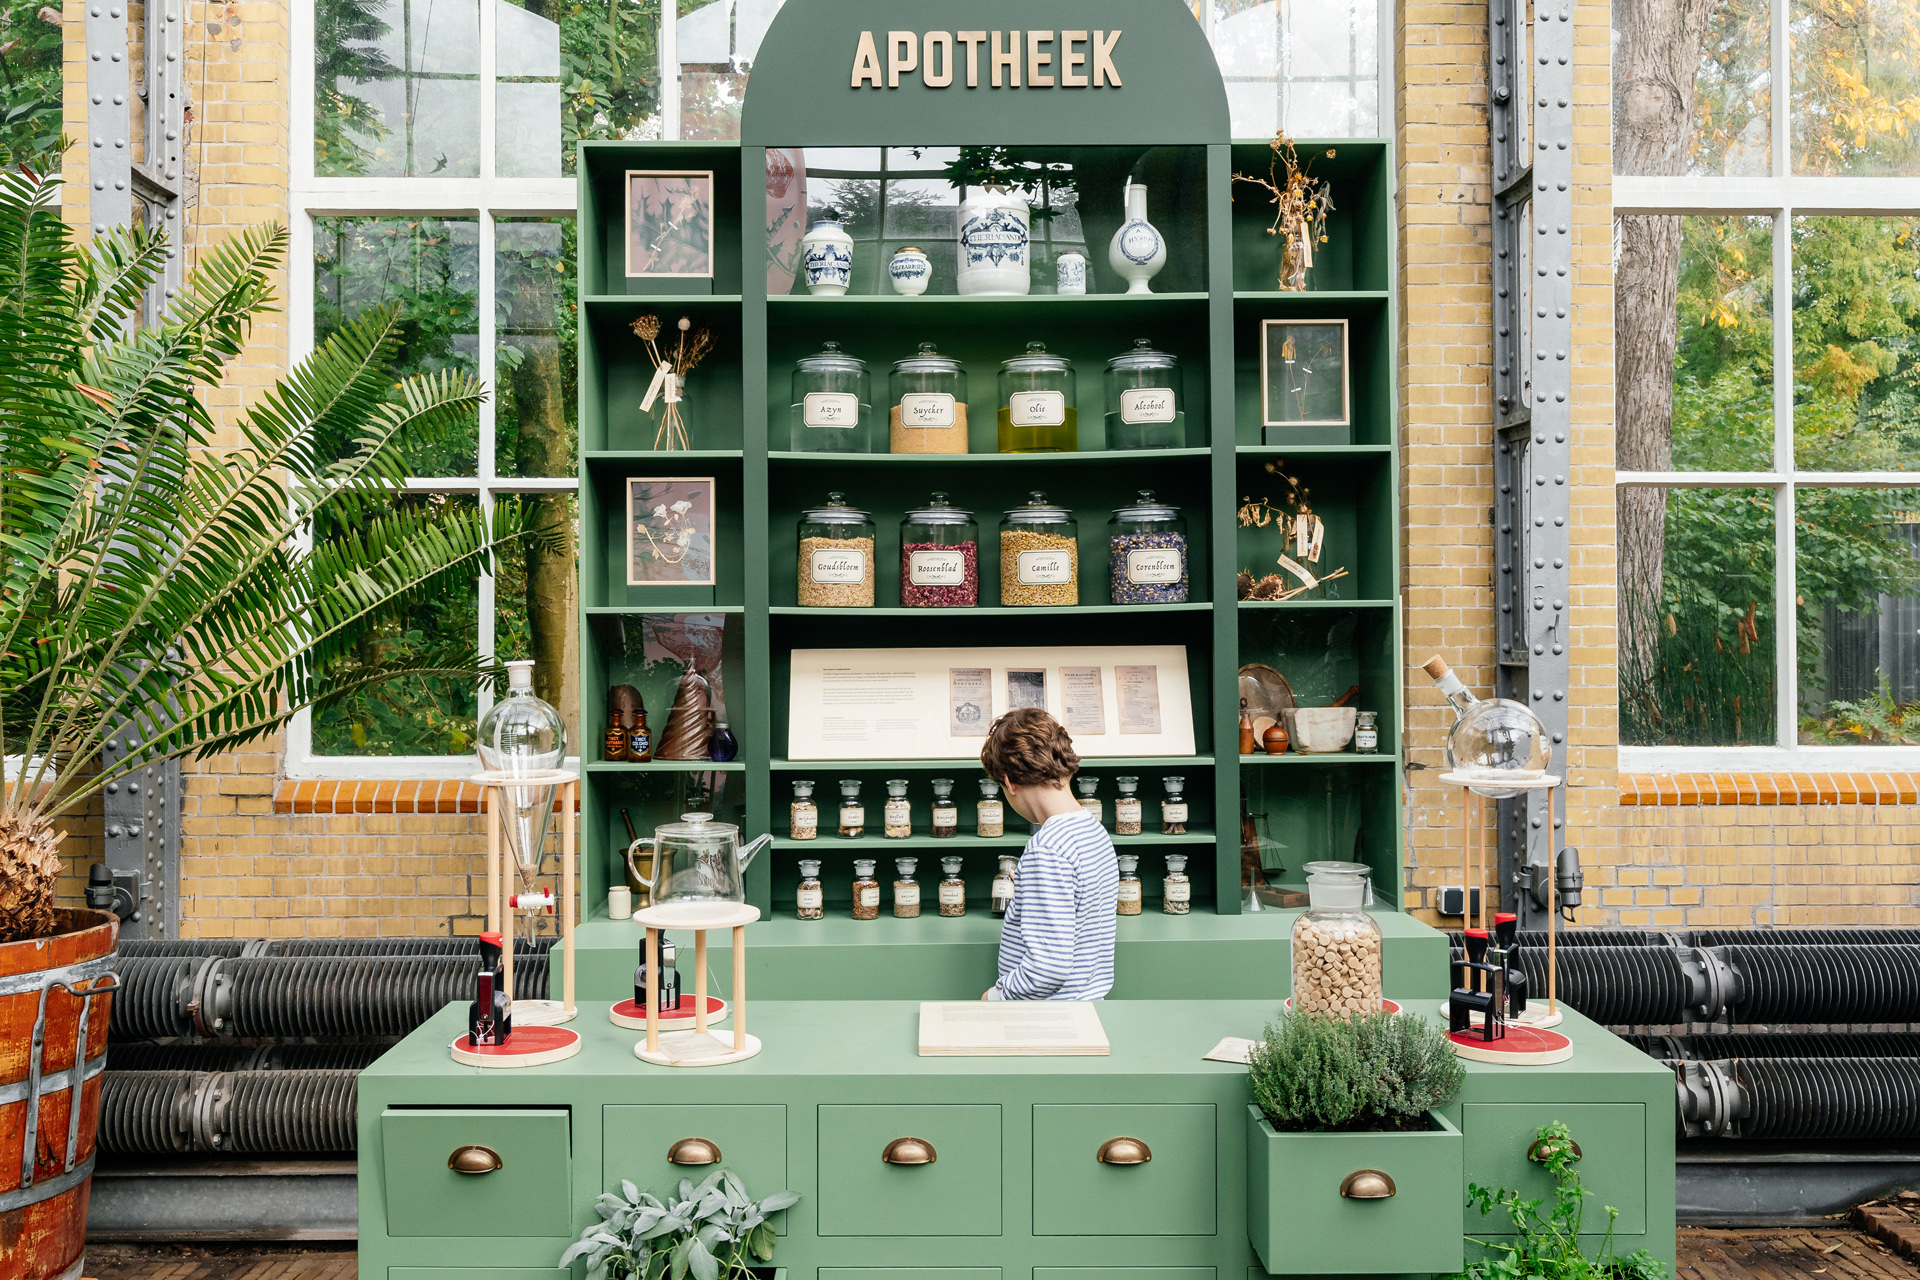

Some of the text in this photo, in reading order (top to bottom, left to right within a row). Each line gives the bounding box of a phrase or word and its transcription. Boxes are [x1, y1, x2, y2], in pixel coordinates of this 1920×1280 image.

[851, 30, 1123, 88] APOTHEEK
[1029, 403, 1046, 413] Olie
[1134, 400, 1166, 411] Alcohool
[820, 406, 842, 417] Azyn
[817, 561, 859, 571] Goudsbloem
[917, 562, 958, 573] Roosenblad
